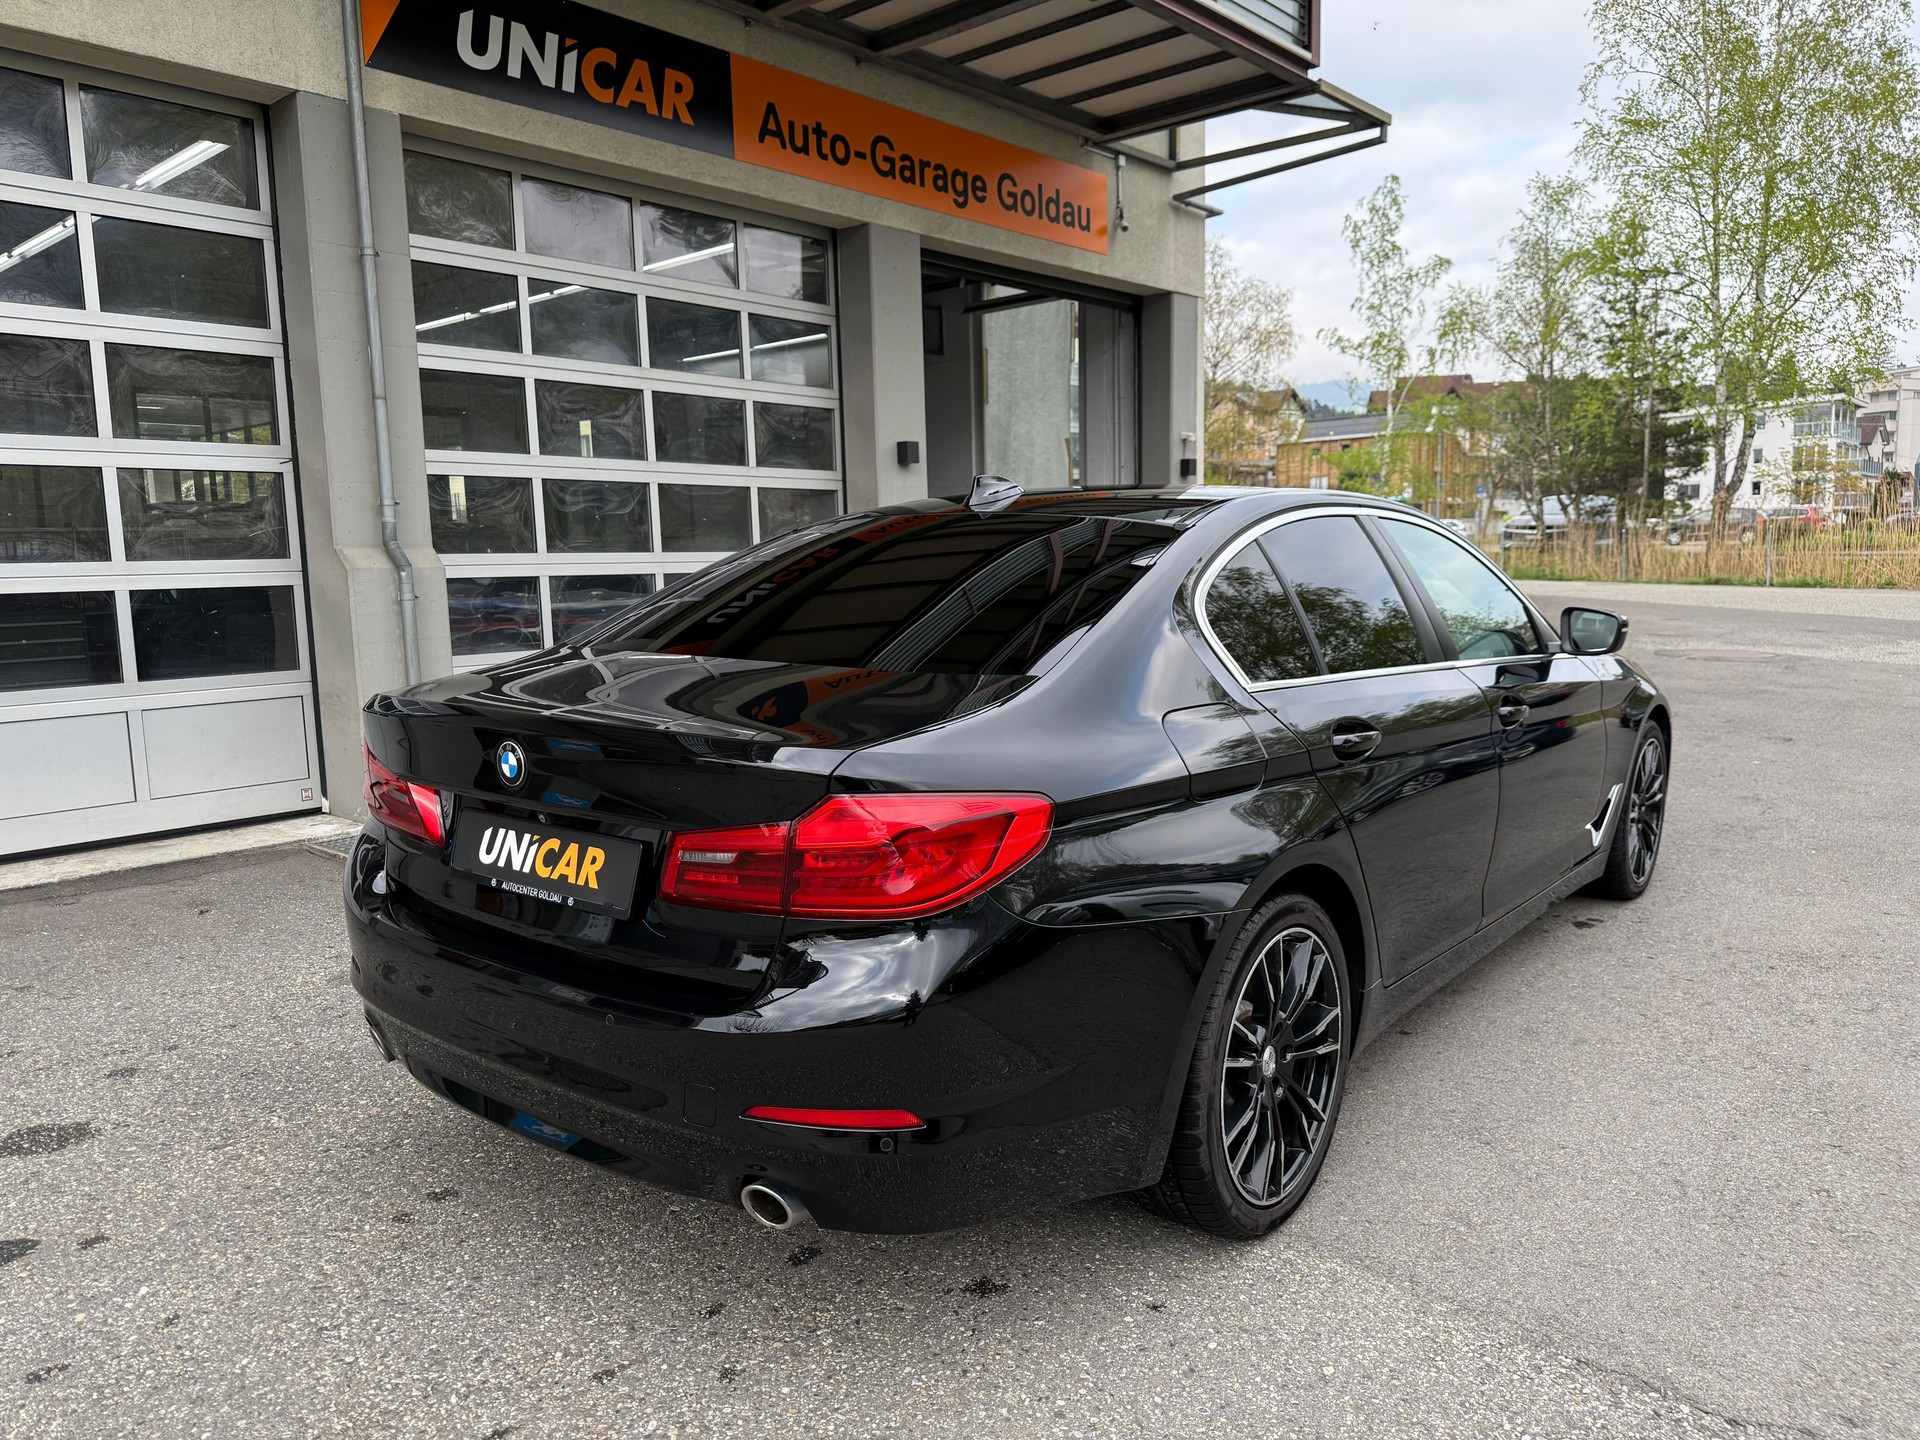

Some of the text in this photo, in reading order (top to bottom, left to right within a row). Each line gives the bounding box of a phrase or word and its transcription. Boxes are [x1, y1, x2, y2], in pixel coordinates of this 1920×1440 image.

[758, 101, 1092, 232] Auto-Garage Goldau
[501, 881, 563, 903] AUTOCENTER GOLDAU
